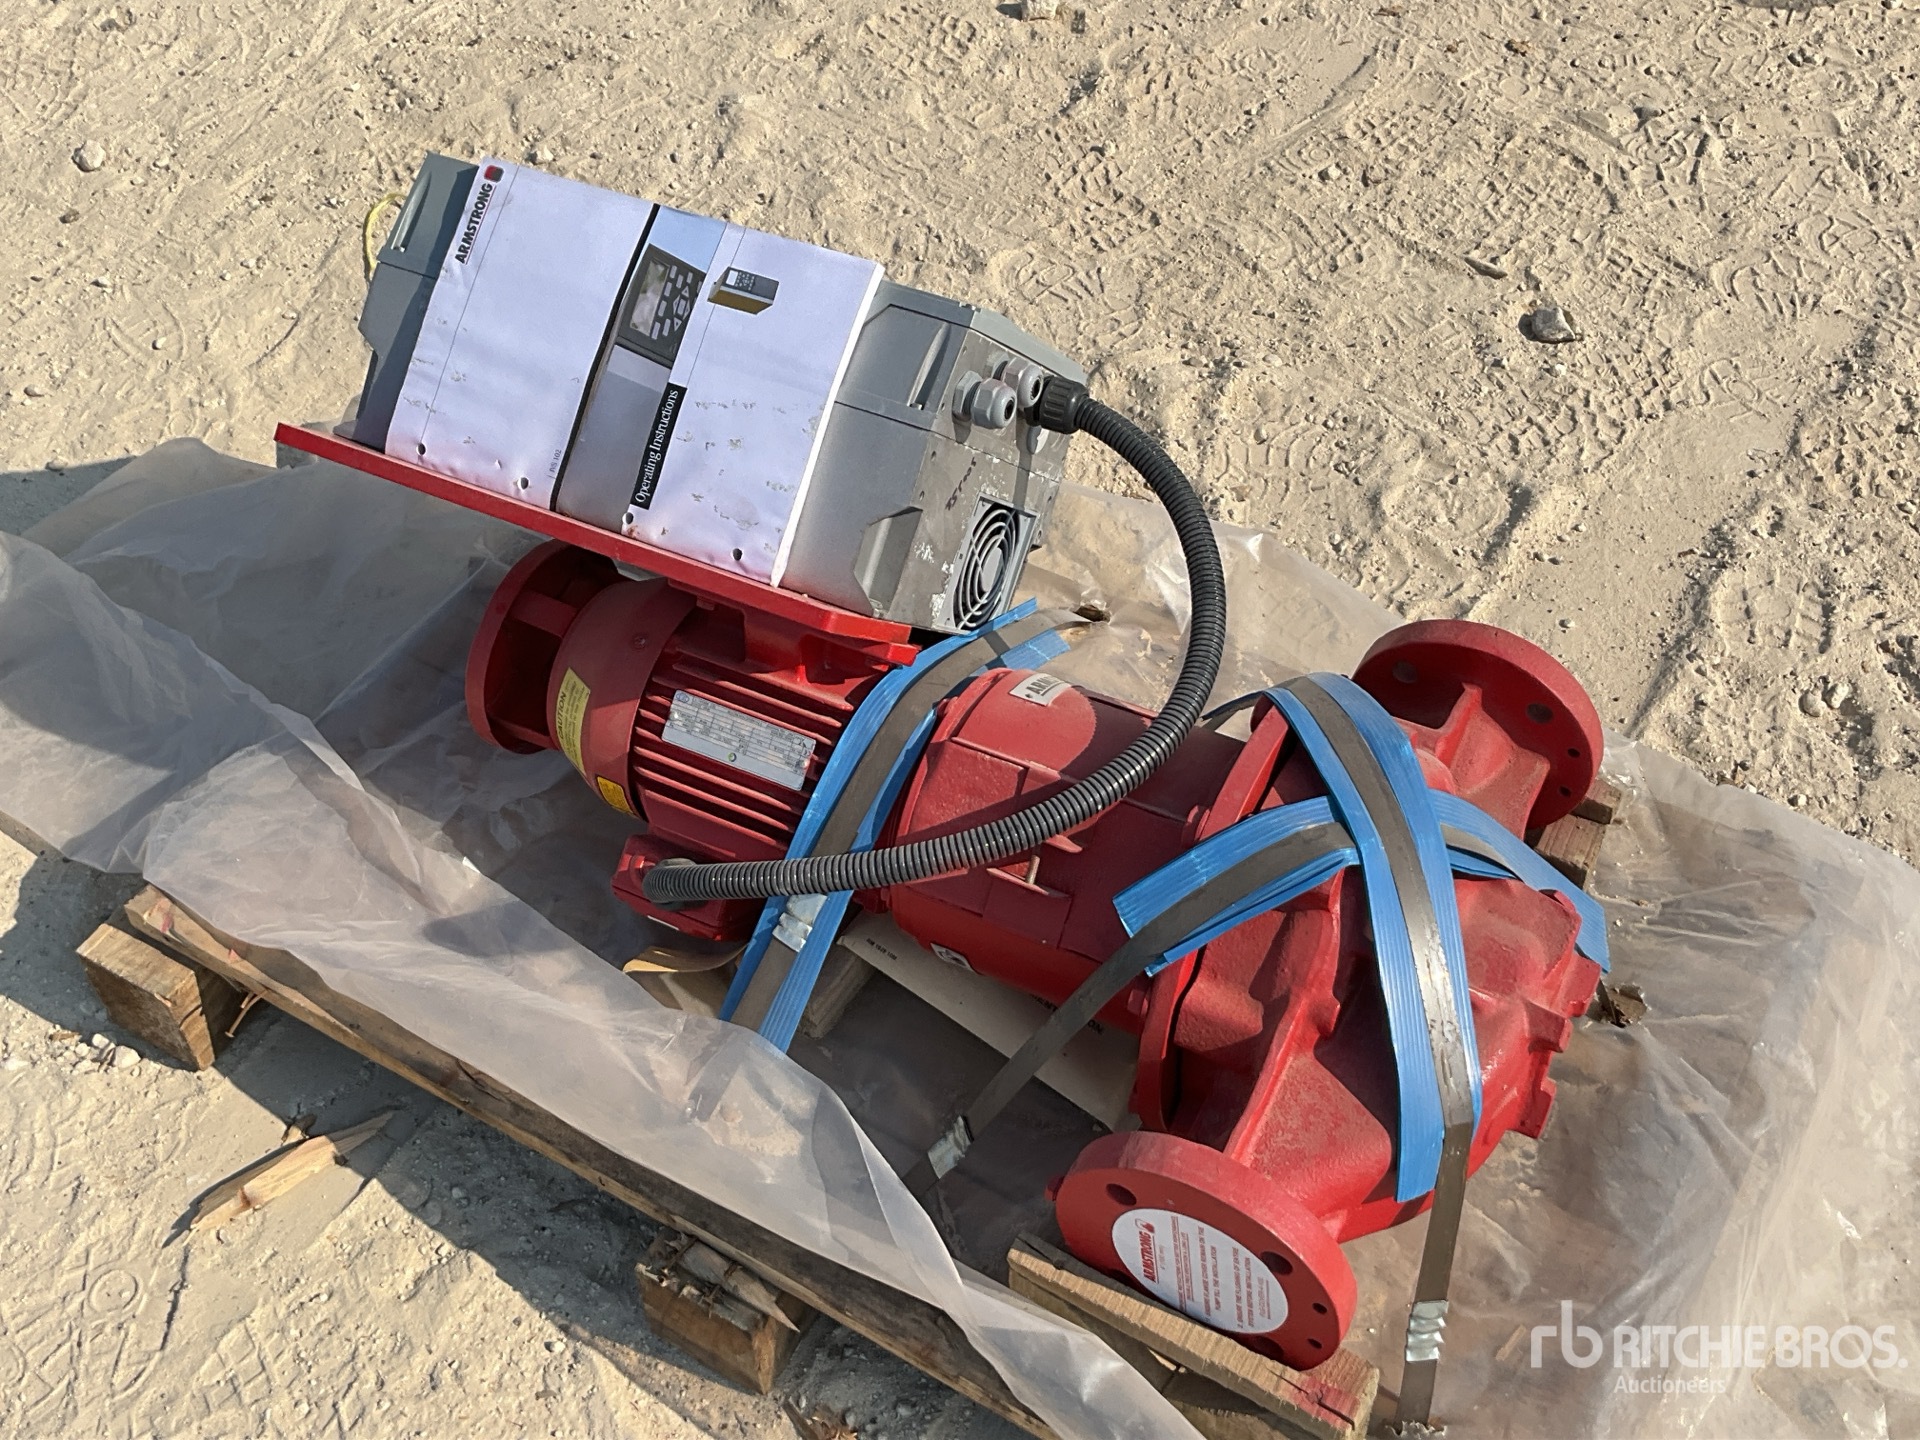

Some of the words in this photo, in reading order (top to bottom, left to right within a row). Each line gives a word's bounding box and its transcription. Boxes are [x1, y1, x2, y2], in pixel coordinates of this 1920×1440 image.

[455, 183, 493, 263] ARMSTRONG
[634, 451, 661, 503] Operating
[649, 389, 679, 451] Instructions
[557, 690, 567, 740] CAUTION
[1139, 1230, 1155, 1282] ARMSTRONG
[1210, 1246, 1218, 1279] INSTALLATION
[1243, 1256, 1252, 1290] INSTALLATION
